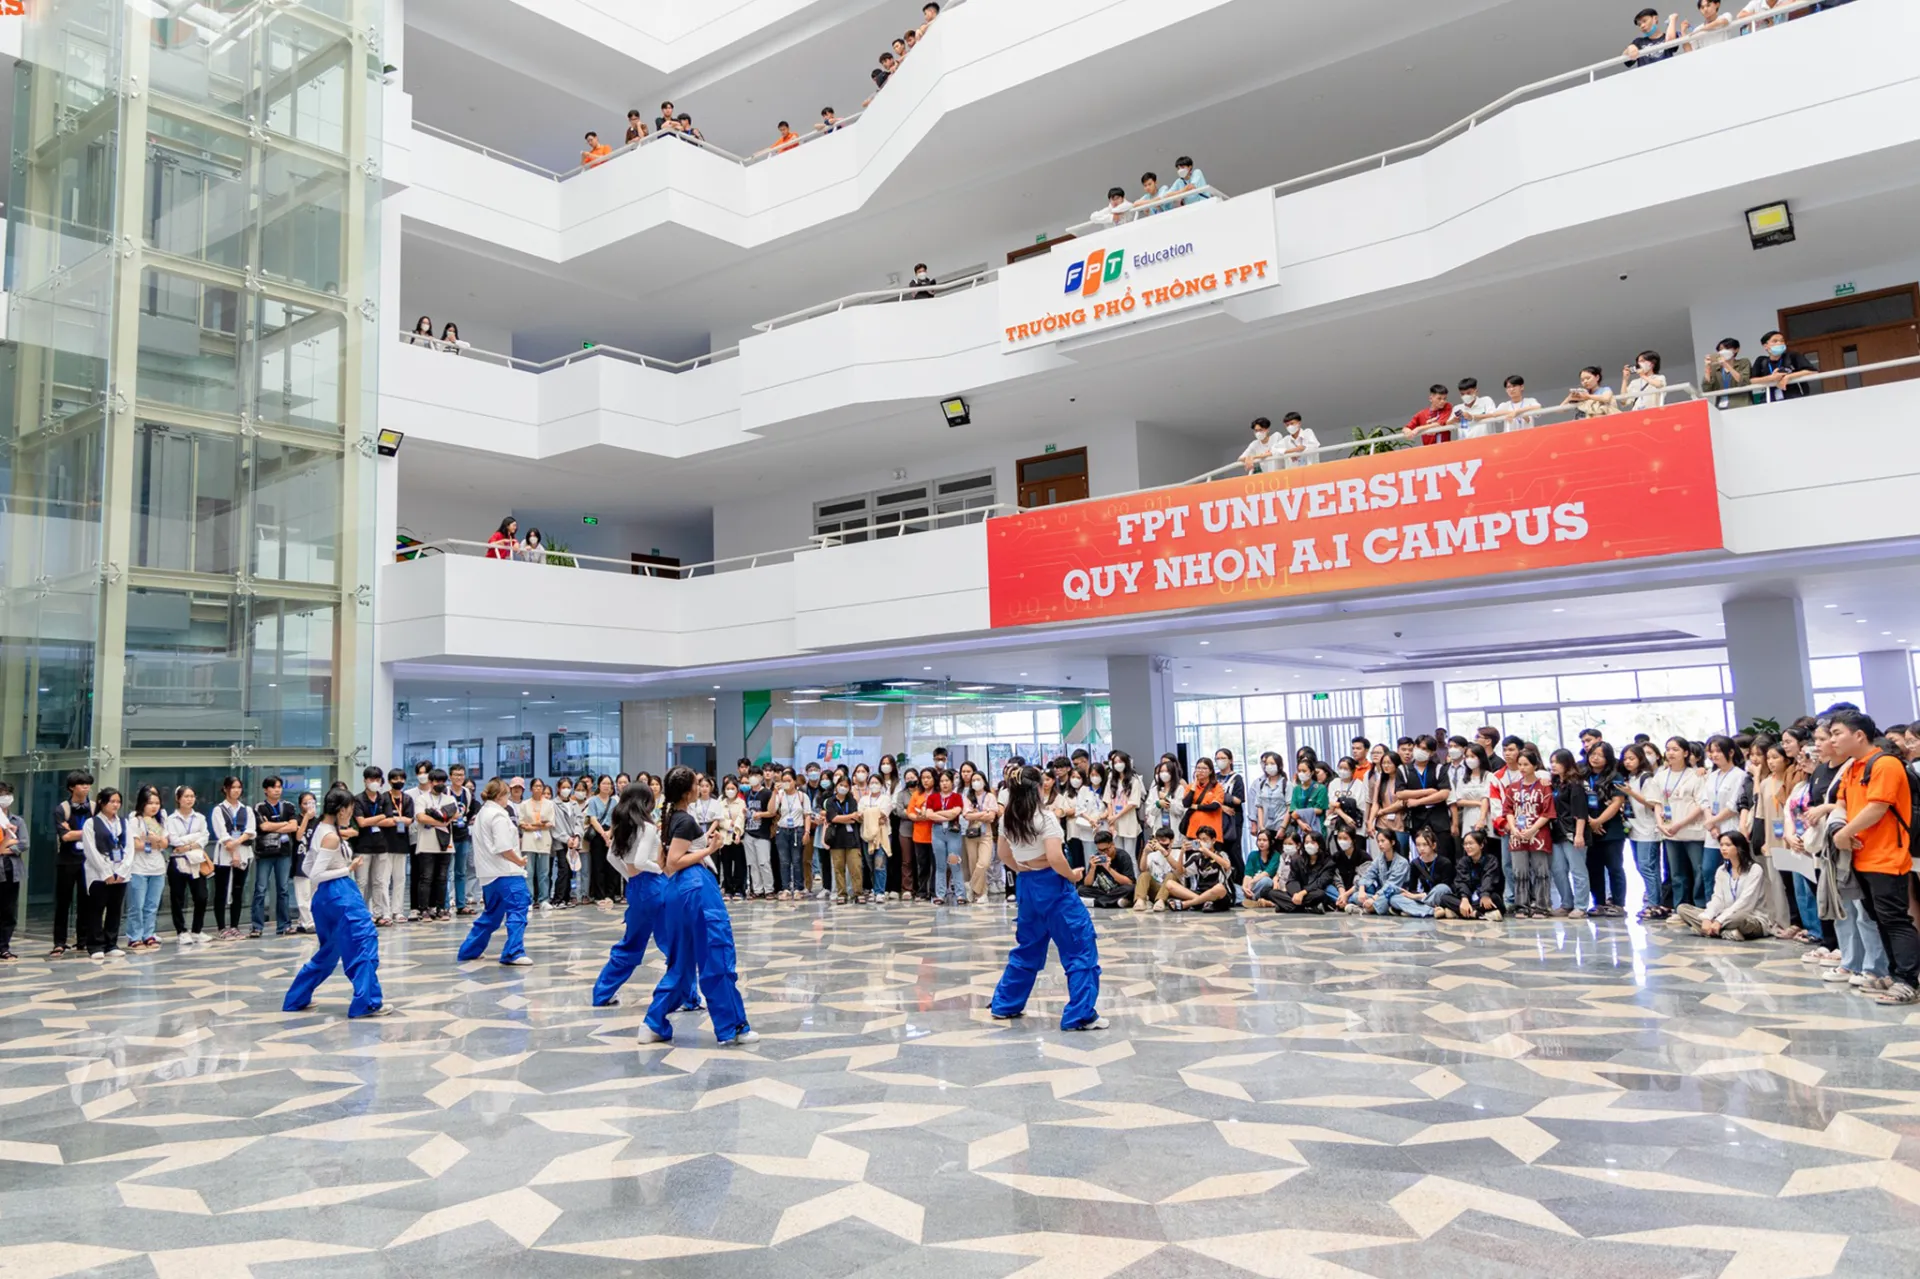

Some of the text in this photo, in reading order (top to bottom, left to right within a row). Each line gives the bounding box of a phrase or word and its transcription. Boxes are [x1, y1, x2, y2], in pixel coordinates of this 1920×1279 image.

[1005, 260, 1268, 342] TRƯỜNG PHỔ THÔNG FPT
[1065, 242, 1193, 294] FPT Education
[1118, 459, 1482, 546] FPT UNIVERSITY
[1063, 501, 1588, 602] QUY NHON A.I CAMPUS
[817, 740, 841, 761] FPT
